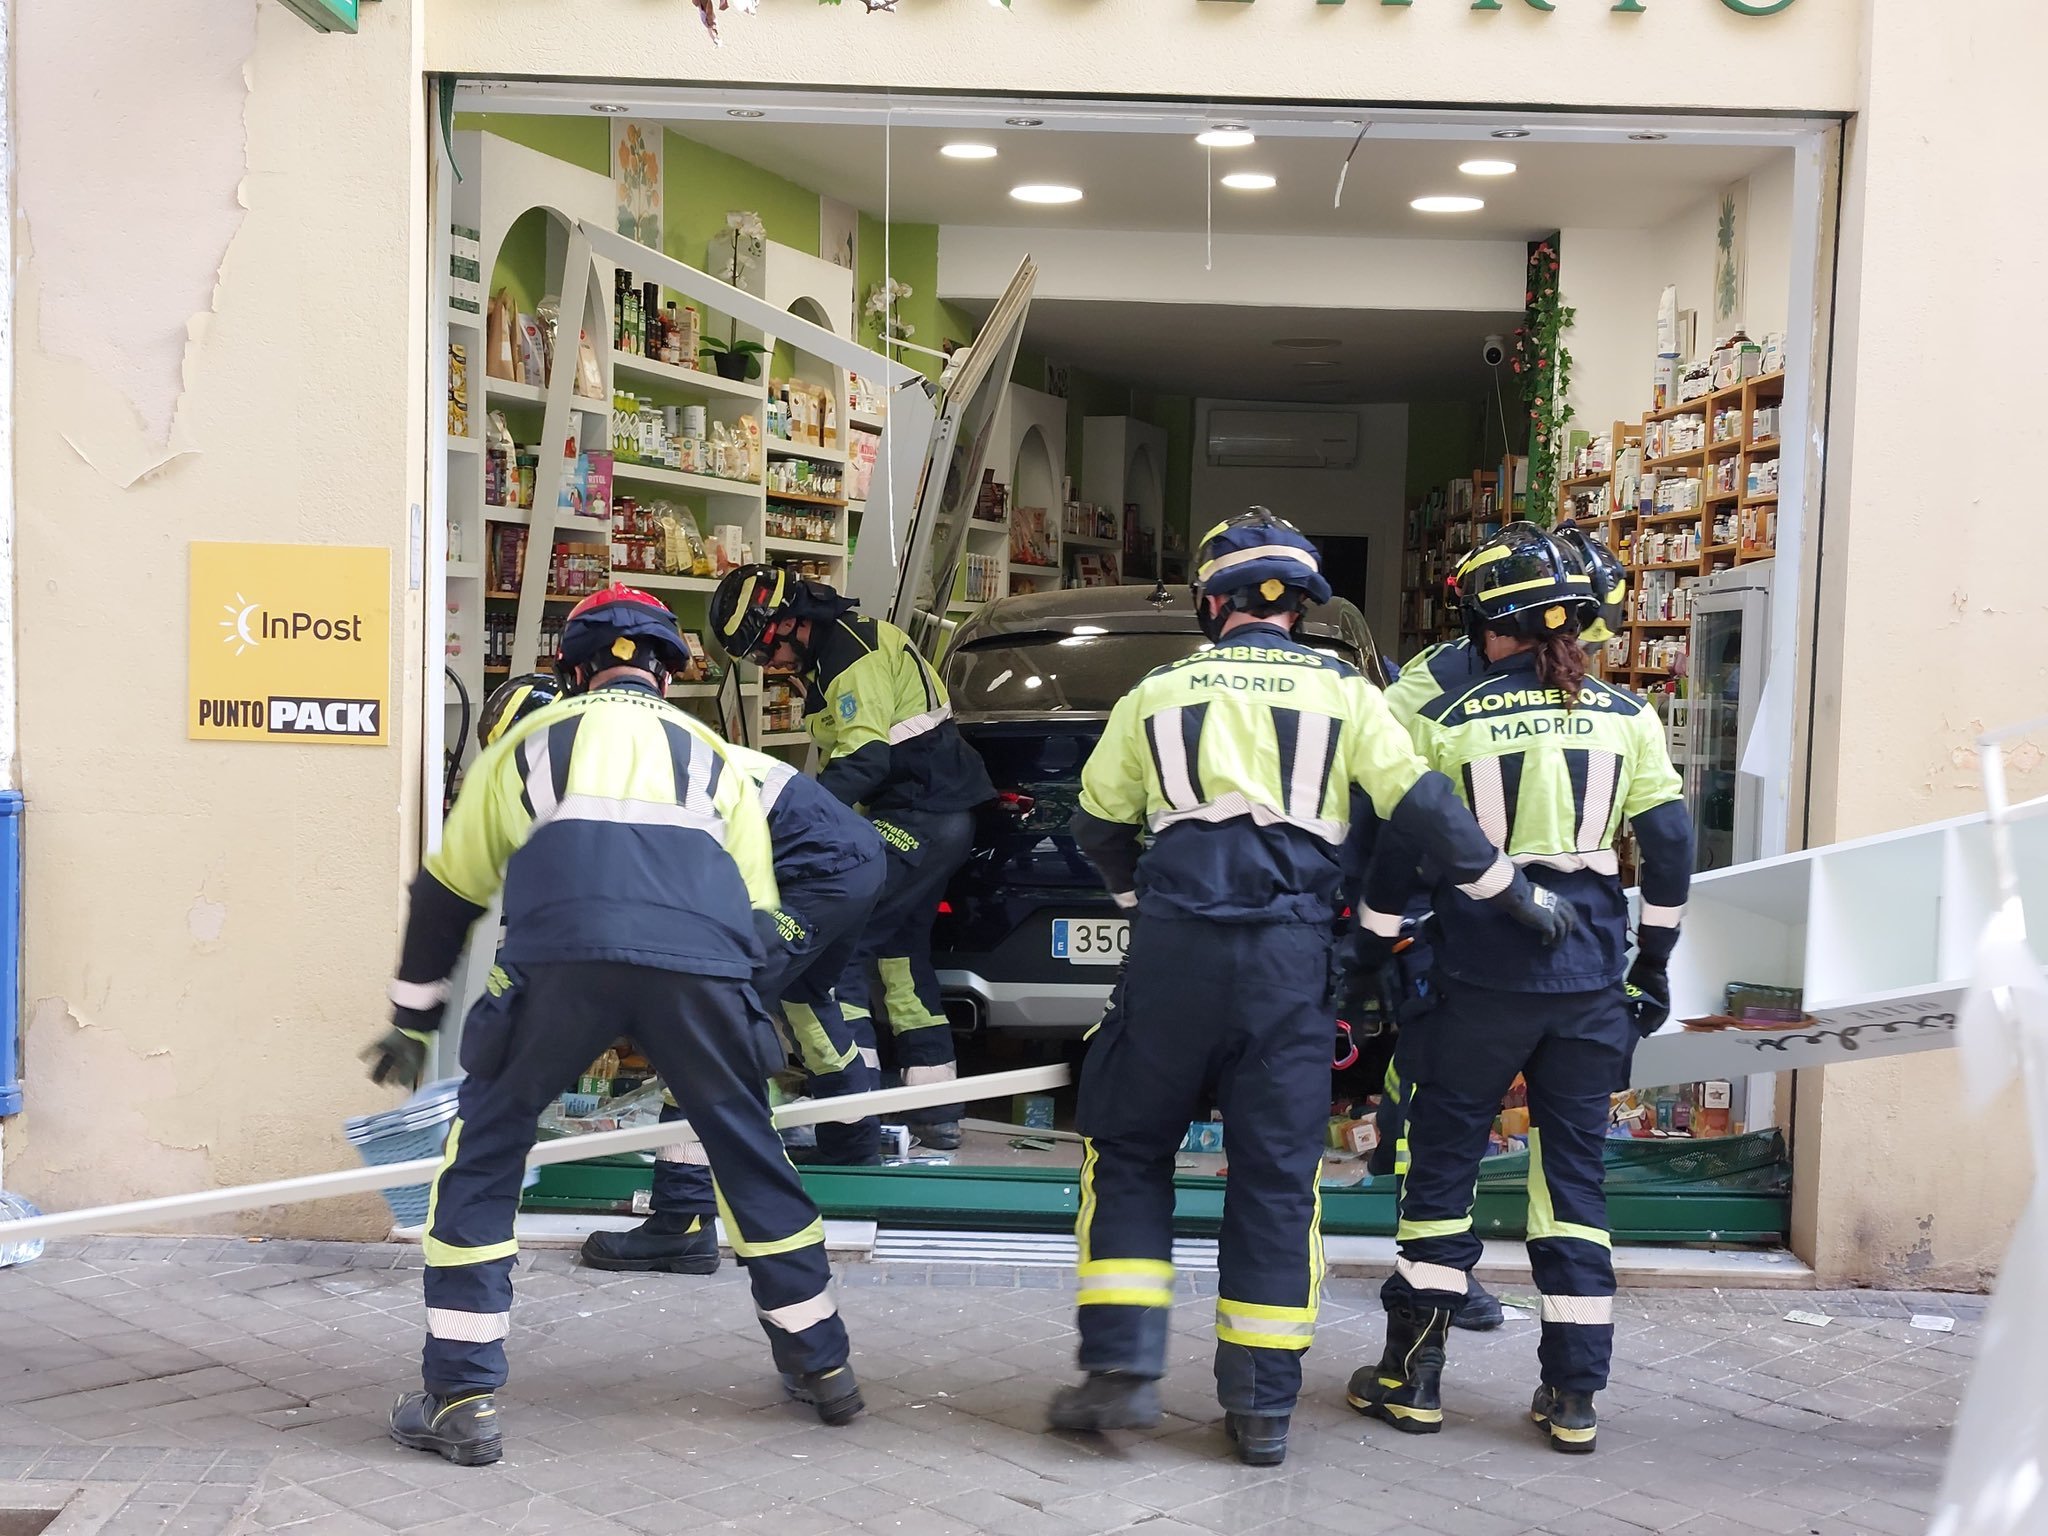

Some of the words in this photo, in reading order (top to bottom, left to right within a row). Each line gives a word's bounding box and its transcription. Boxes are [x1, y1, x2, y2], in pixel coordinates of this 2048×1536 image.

[262, 611, 362, 642] InPost
[1171, 646, 1323, 668] BOMBEROS
[1189, 673, 1296, 693] MADRID
[1463, 687, 1613, 716] BOMBEOS
[199, 698, 264, 728] PUNTO
[270, 701, 377, 732] PACK
[1490, 717, 1594, 742] MADRID
[1057, 941, 1064, 951] E
